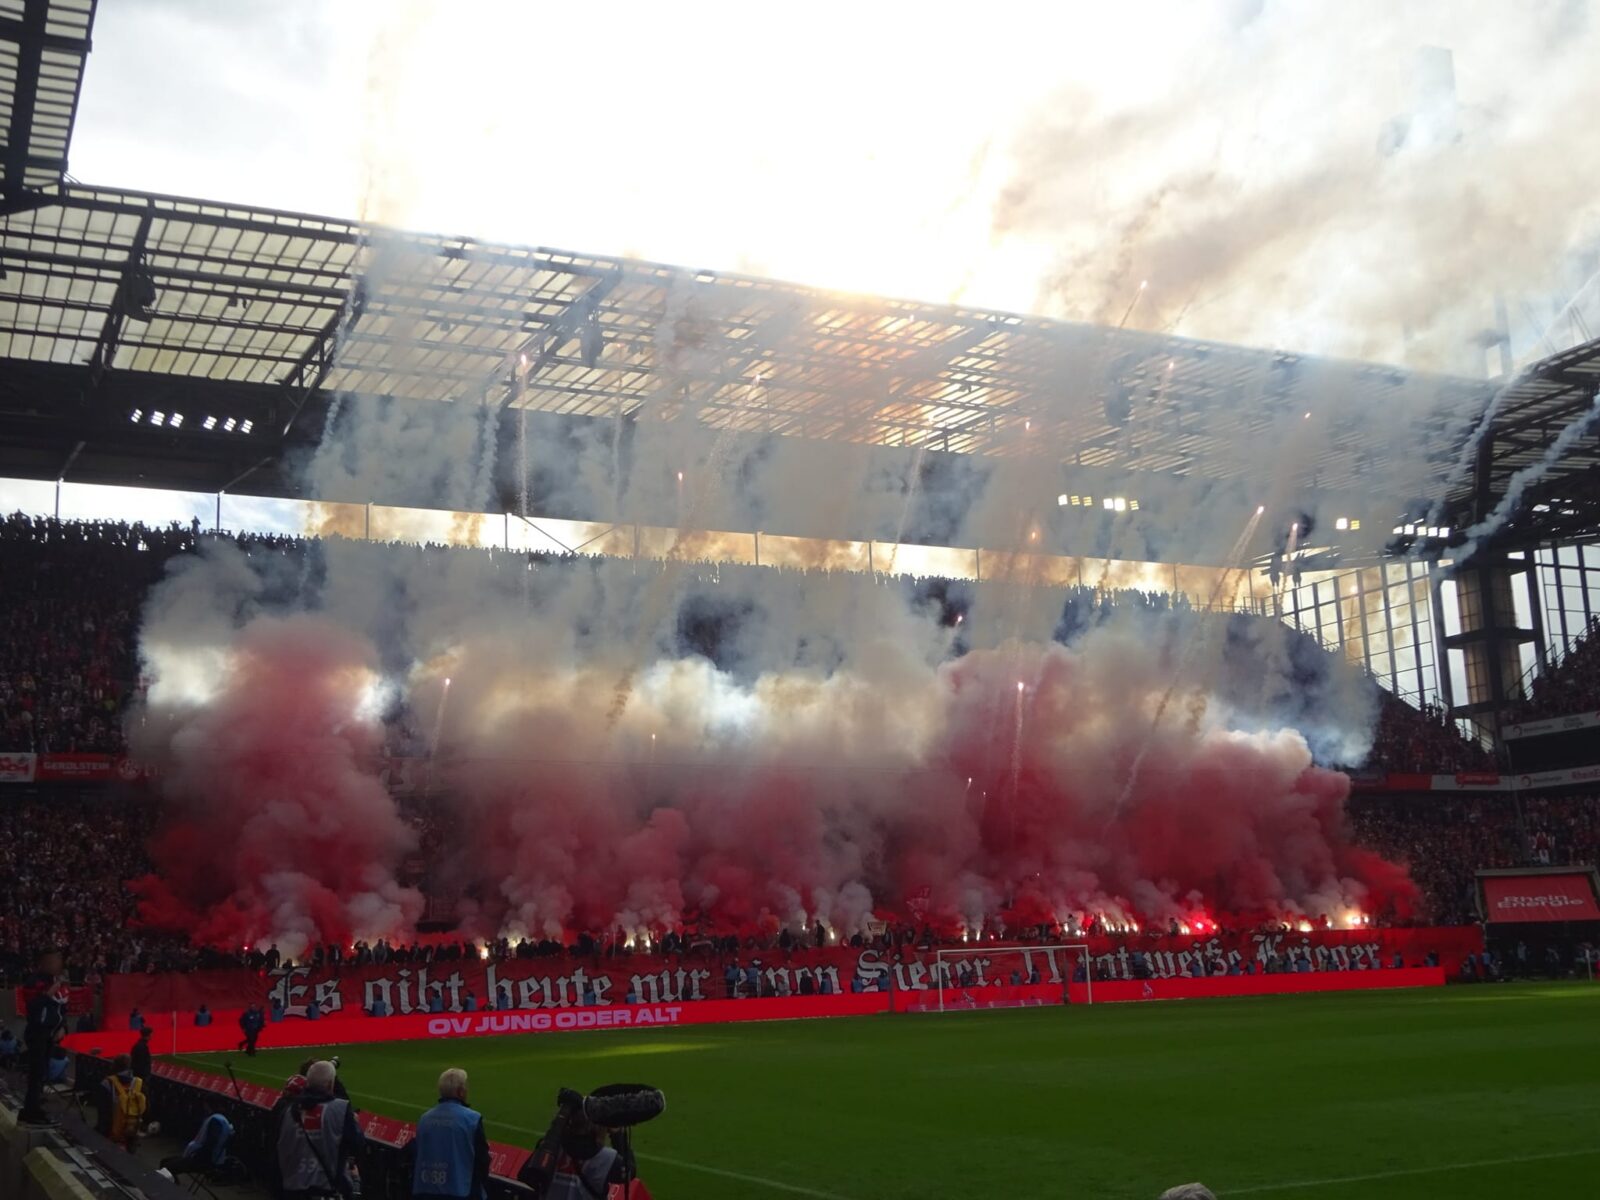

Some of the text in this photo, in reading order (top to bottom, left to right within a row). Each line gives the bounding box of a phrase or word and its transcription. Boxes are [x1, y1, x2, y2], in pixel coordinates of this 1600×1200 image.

[1497, 899, 1585, 909] Energie
[268, 967, 342, 1017] Es
[363, 968, 465, 1016] gibt
[486, 963, 612, 1010] heute
[631, 967, 710, 1004] nur
[857, 949, 1002, 992] Sieger.
[1251, 933, 1367, 970] Krieger
[428, 1006, 682, 1035] OV JUNG ODER ALT
